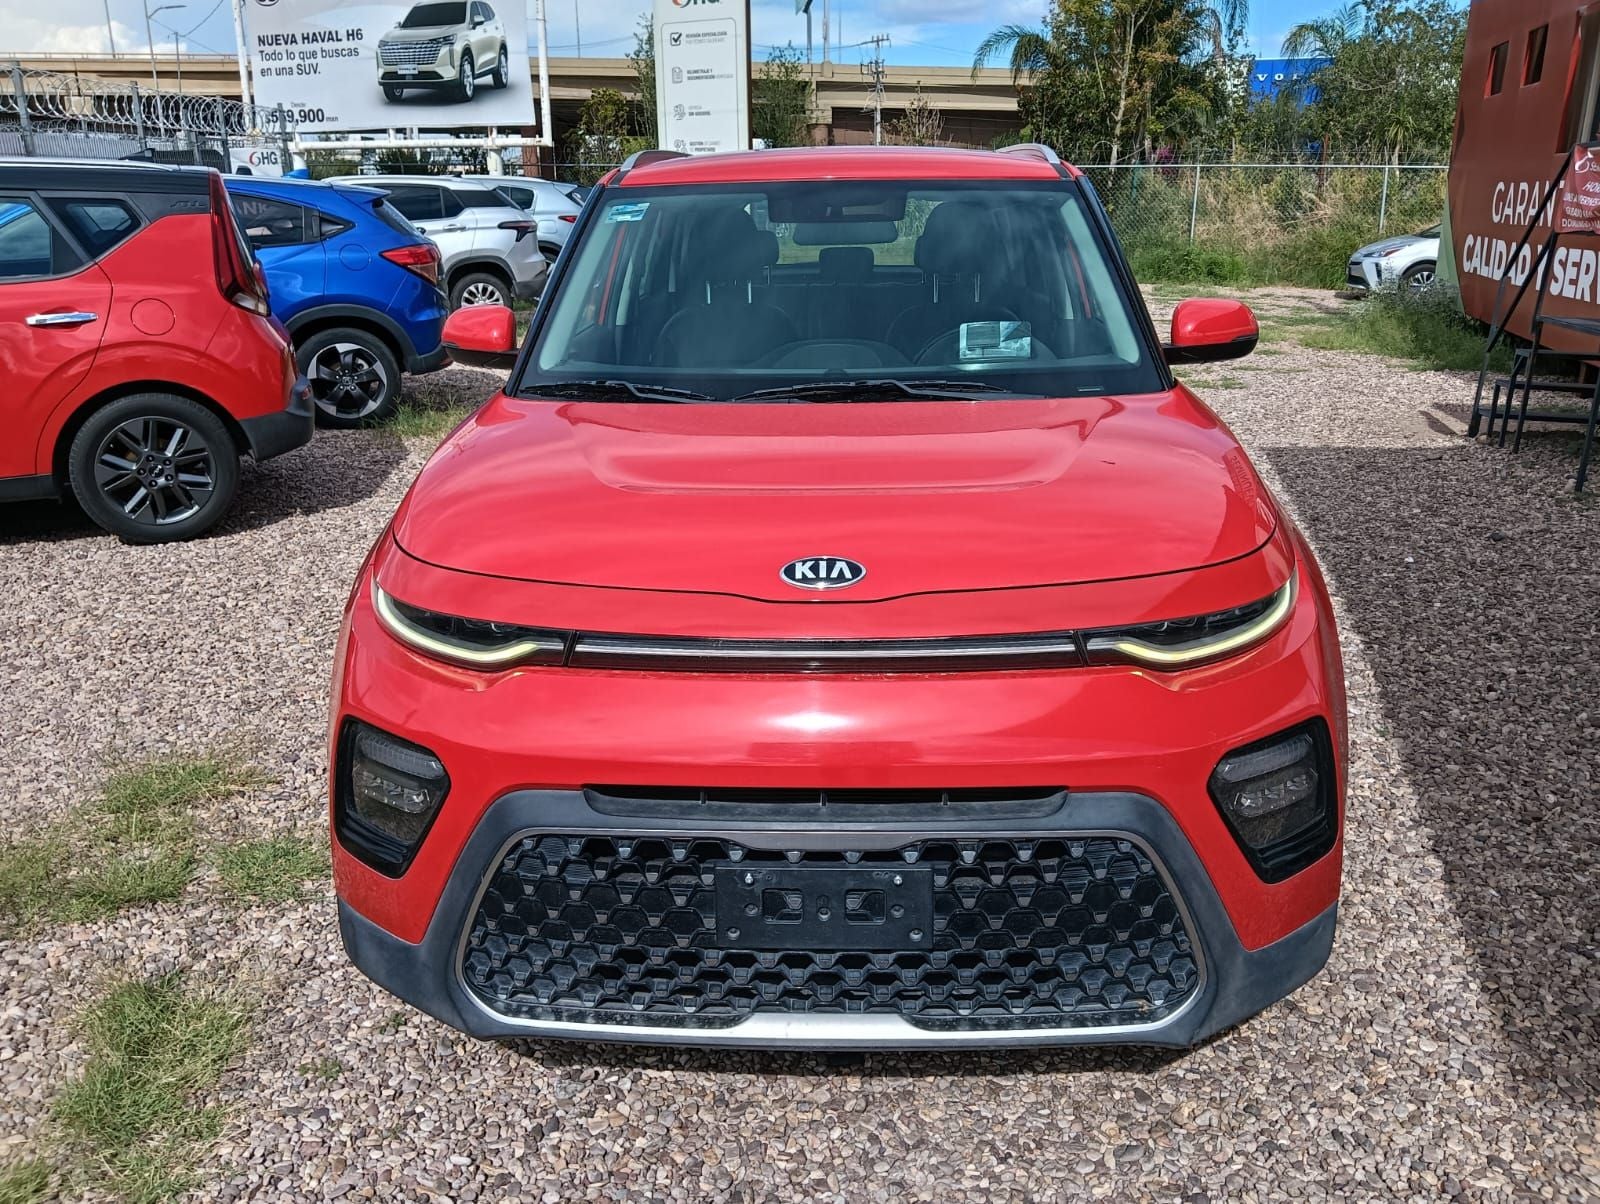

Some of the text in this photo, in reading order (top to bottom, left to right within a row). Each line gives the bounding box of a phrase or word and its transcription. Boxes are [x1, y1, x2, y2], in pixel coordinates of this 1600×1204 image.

[257, 28, 363, 47] NUEVA HAVAL H6
[259, 46, 359, 63] Todo lo que buscas
[260, 62, 321, 77] en una SUV.
[1463, 234, 1531, 287] CALIDAD
[795, 560, 852, 579] KIA
